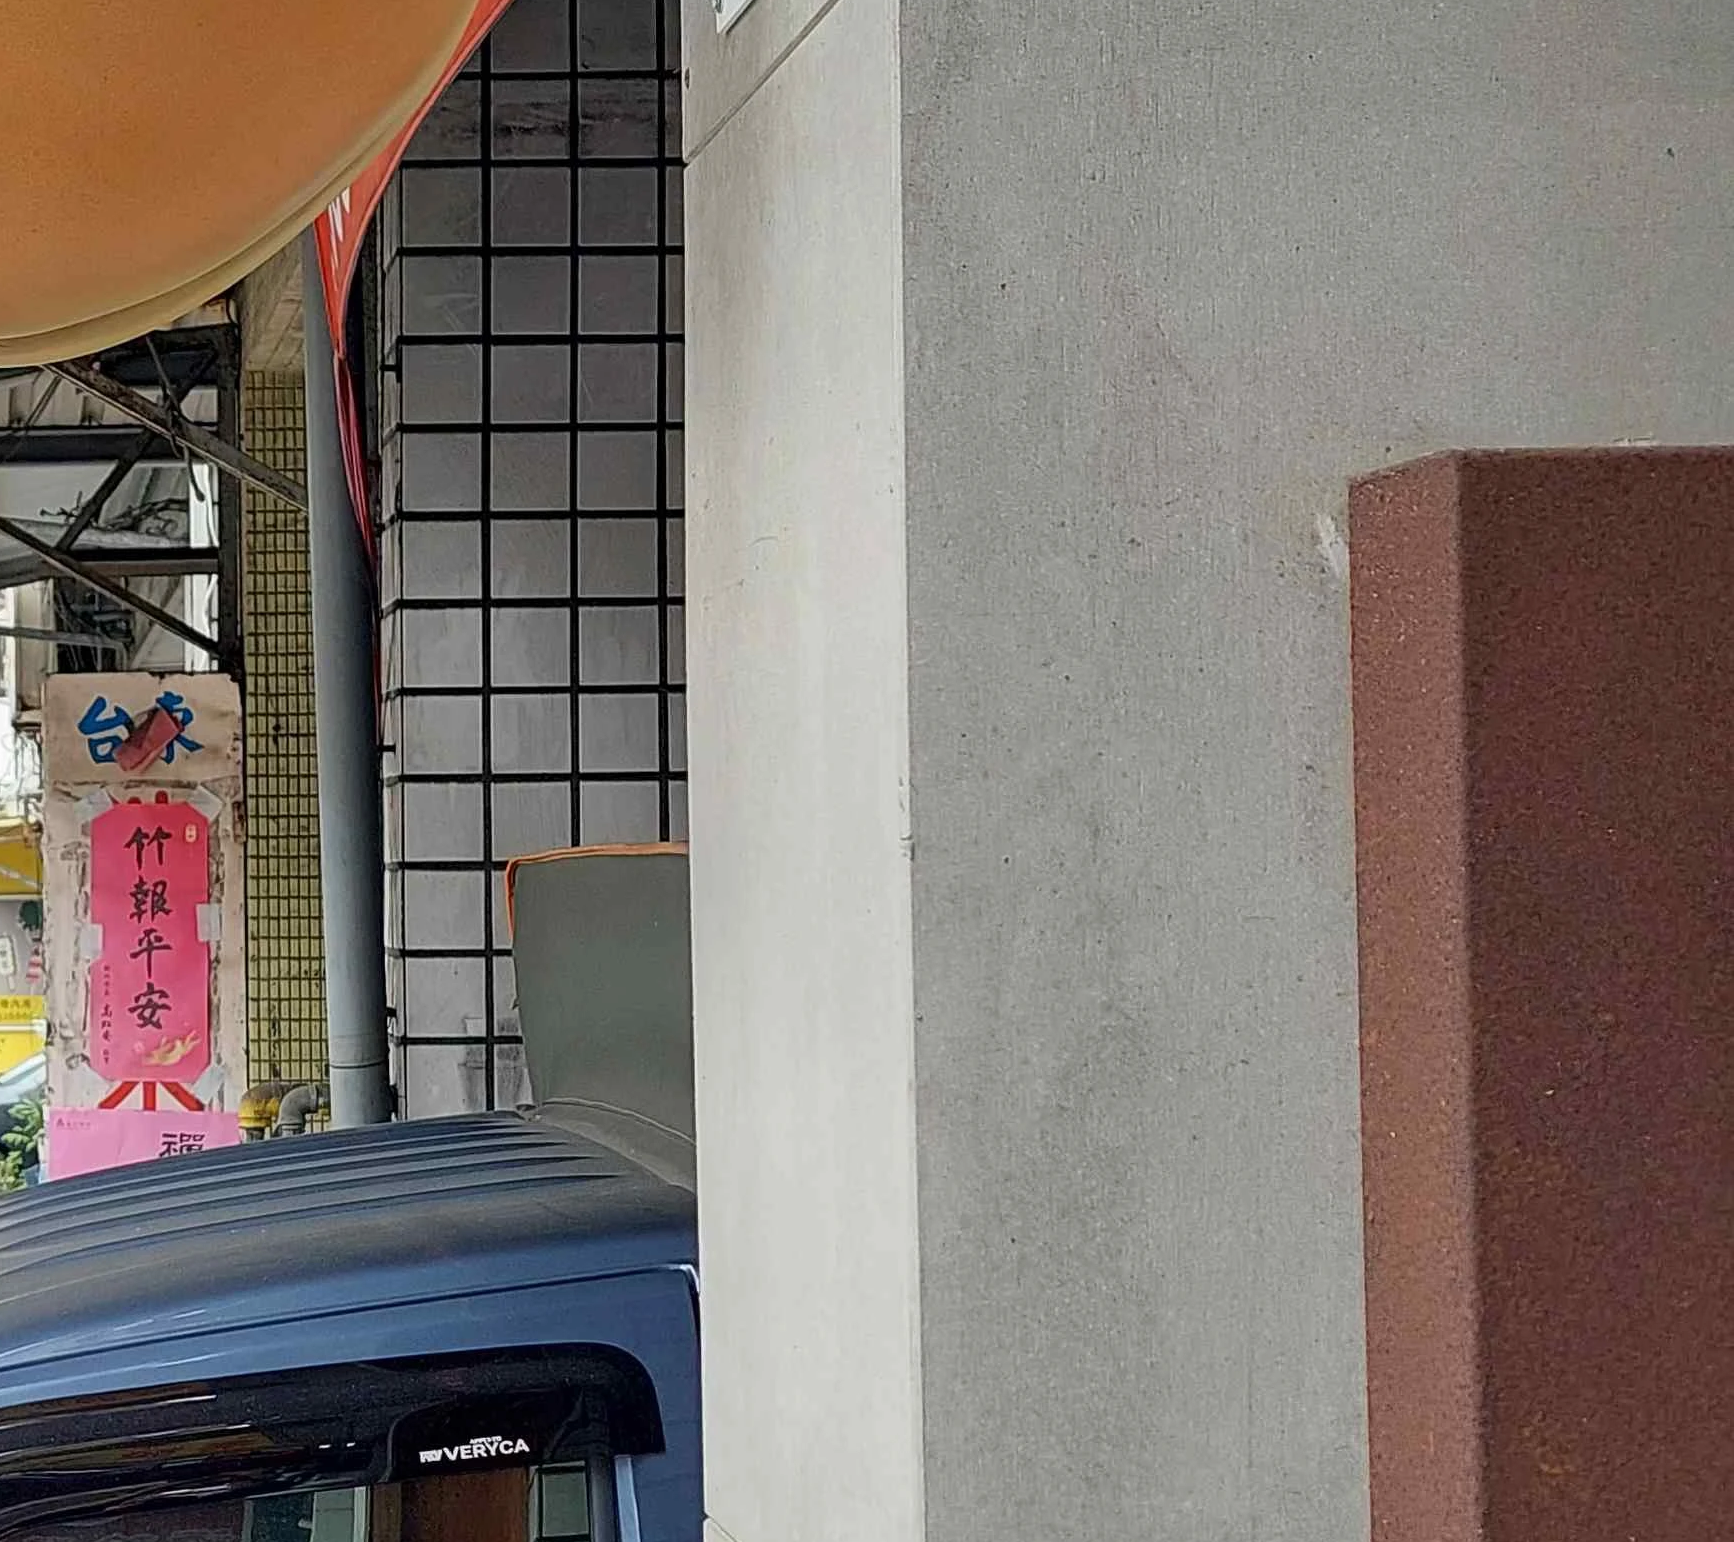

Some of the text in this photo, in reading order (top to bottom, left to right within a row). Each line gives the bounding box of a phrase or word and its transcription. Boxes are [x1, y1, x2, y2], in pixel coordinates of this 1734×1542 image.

[124, 825, 173, 1030] 竹報平安
[443, 1438, 530, 1461] VERYCA
